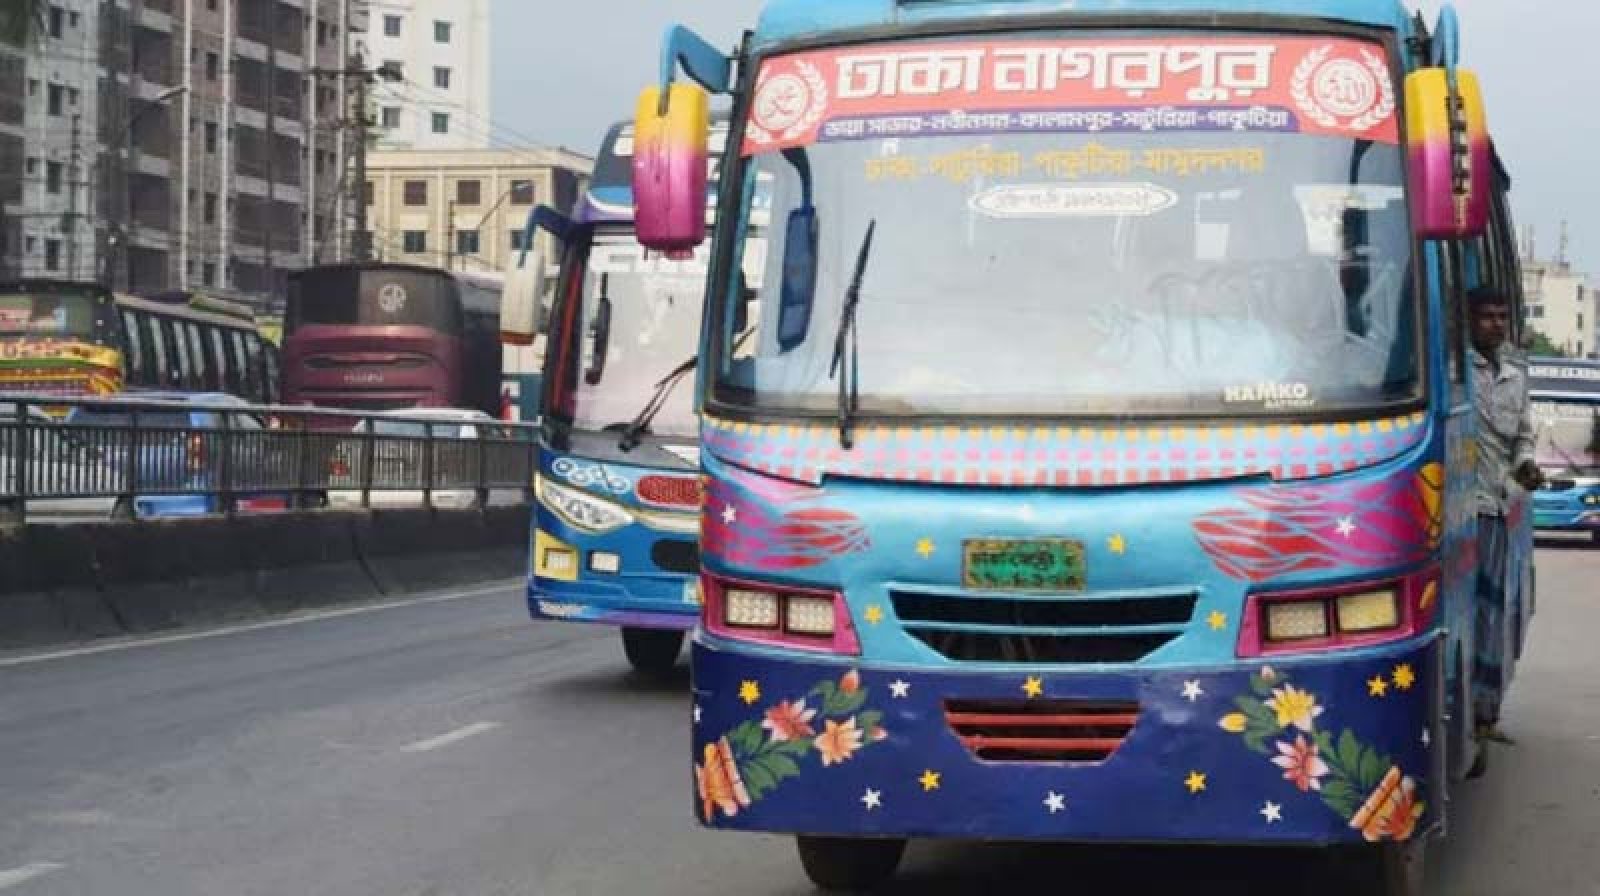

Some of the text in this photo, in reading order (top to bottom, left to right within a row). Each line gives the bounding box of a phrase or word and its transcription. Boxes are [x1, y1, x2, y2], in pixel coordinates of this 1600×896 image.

[834, 50, 986, 98] ঢাকা
[992, 45, 1276, 101] নাগরপুর
[1223, 382, 1309, 402] HAMKO
